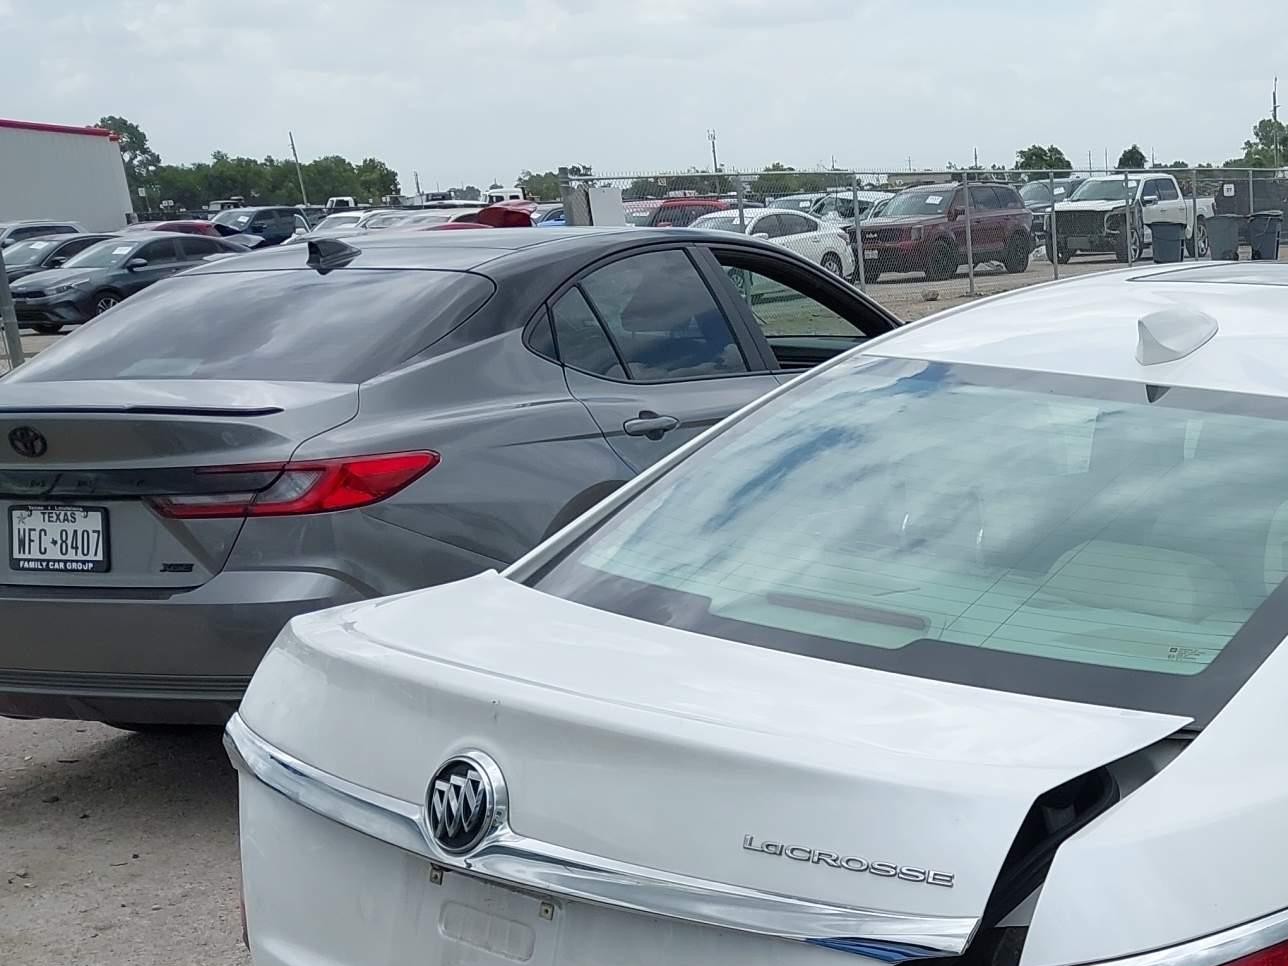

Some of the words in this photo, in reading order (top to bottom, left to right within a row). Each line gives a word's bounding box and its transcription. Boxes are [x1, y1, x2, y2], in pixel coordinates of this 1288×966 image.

[40, 511, 77, 523] TEXAS
[20, 560, 47, 569] FAMILY
[49, 561, 65, 570] CAR
[66, 562, 94, 571] GROUP
